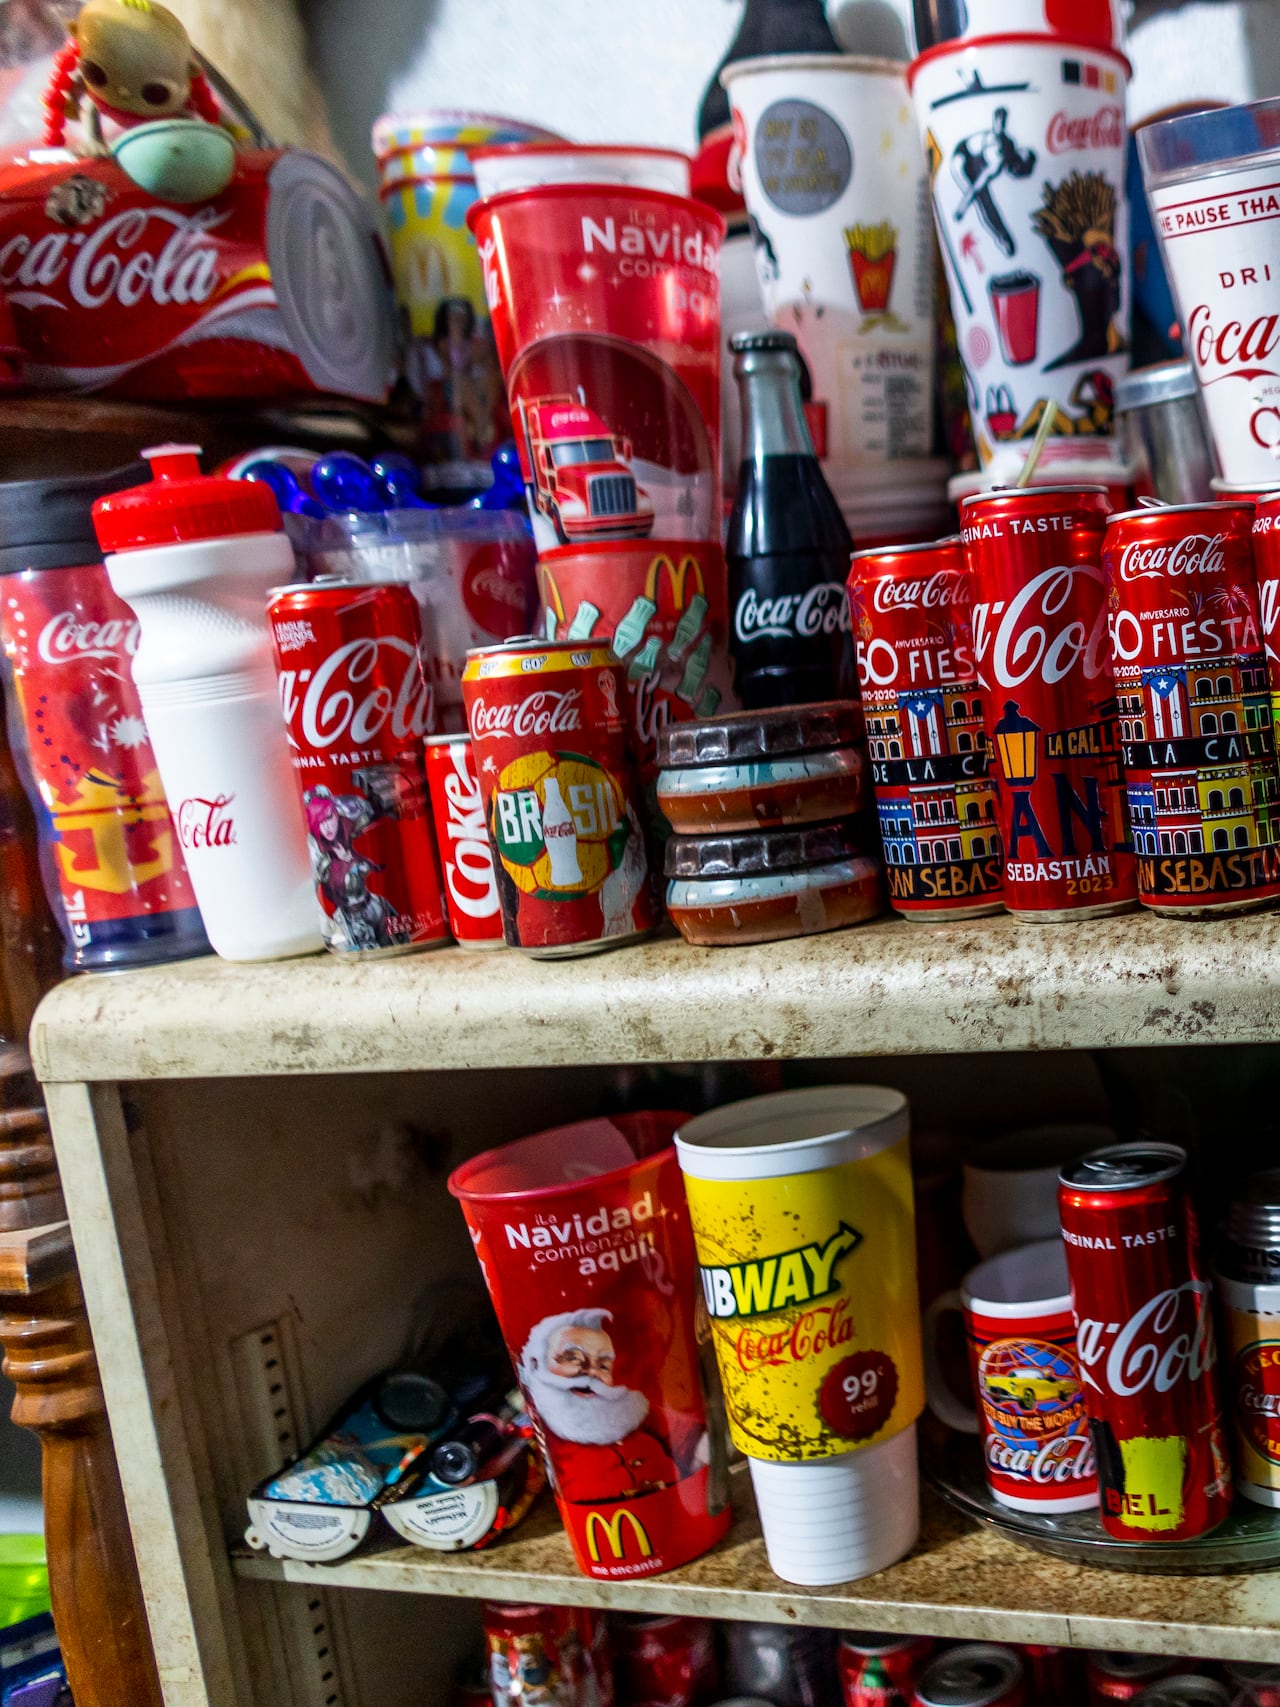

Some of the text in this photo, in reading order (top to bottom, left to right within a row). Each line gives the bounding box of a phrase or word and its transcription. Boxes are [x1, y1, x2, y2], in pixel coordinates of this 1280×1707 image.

[1176, 204, 1231, 229] PAUSE
[1009, 516, 1074, 535] TASTE
[1120, 532, 1229, 583] Coca-Cola
[873, 569, 971, 614] Coca-Cola
[1139, 607, 1190, 621] ANIVERSARIO
[1152, 615, 1260, 658] FIESTA
[471, 688, 584, 742] Coca-Cola
[329, 750, 383, 766] TASTE
[1048, 734, 1064, 756] LA
[1148, 743, 1177, 766] LA
[873, 762, 889, 783] DE
[906, 760, 936, 781] LA
[444, 743, 501, 919] Coke
[1007, 854, 1110, 882] SEBASTIÁN
[887, 866, 914, 898] SAN
[1066, 875, 1114, 896] 2023
[504, 1190, 654, 1250] Navidad
[534, 1229, 635, 1264] comienza
[1121, 1225, 1177, 1249] TASTE
[736, 1298, 857, 1373] Coca-Cola
[1018, 1416, 1044, 1431] THE
